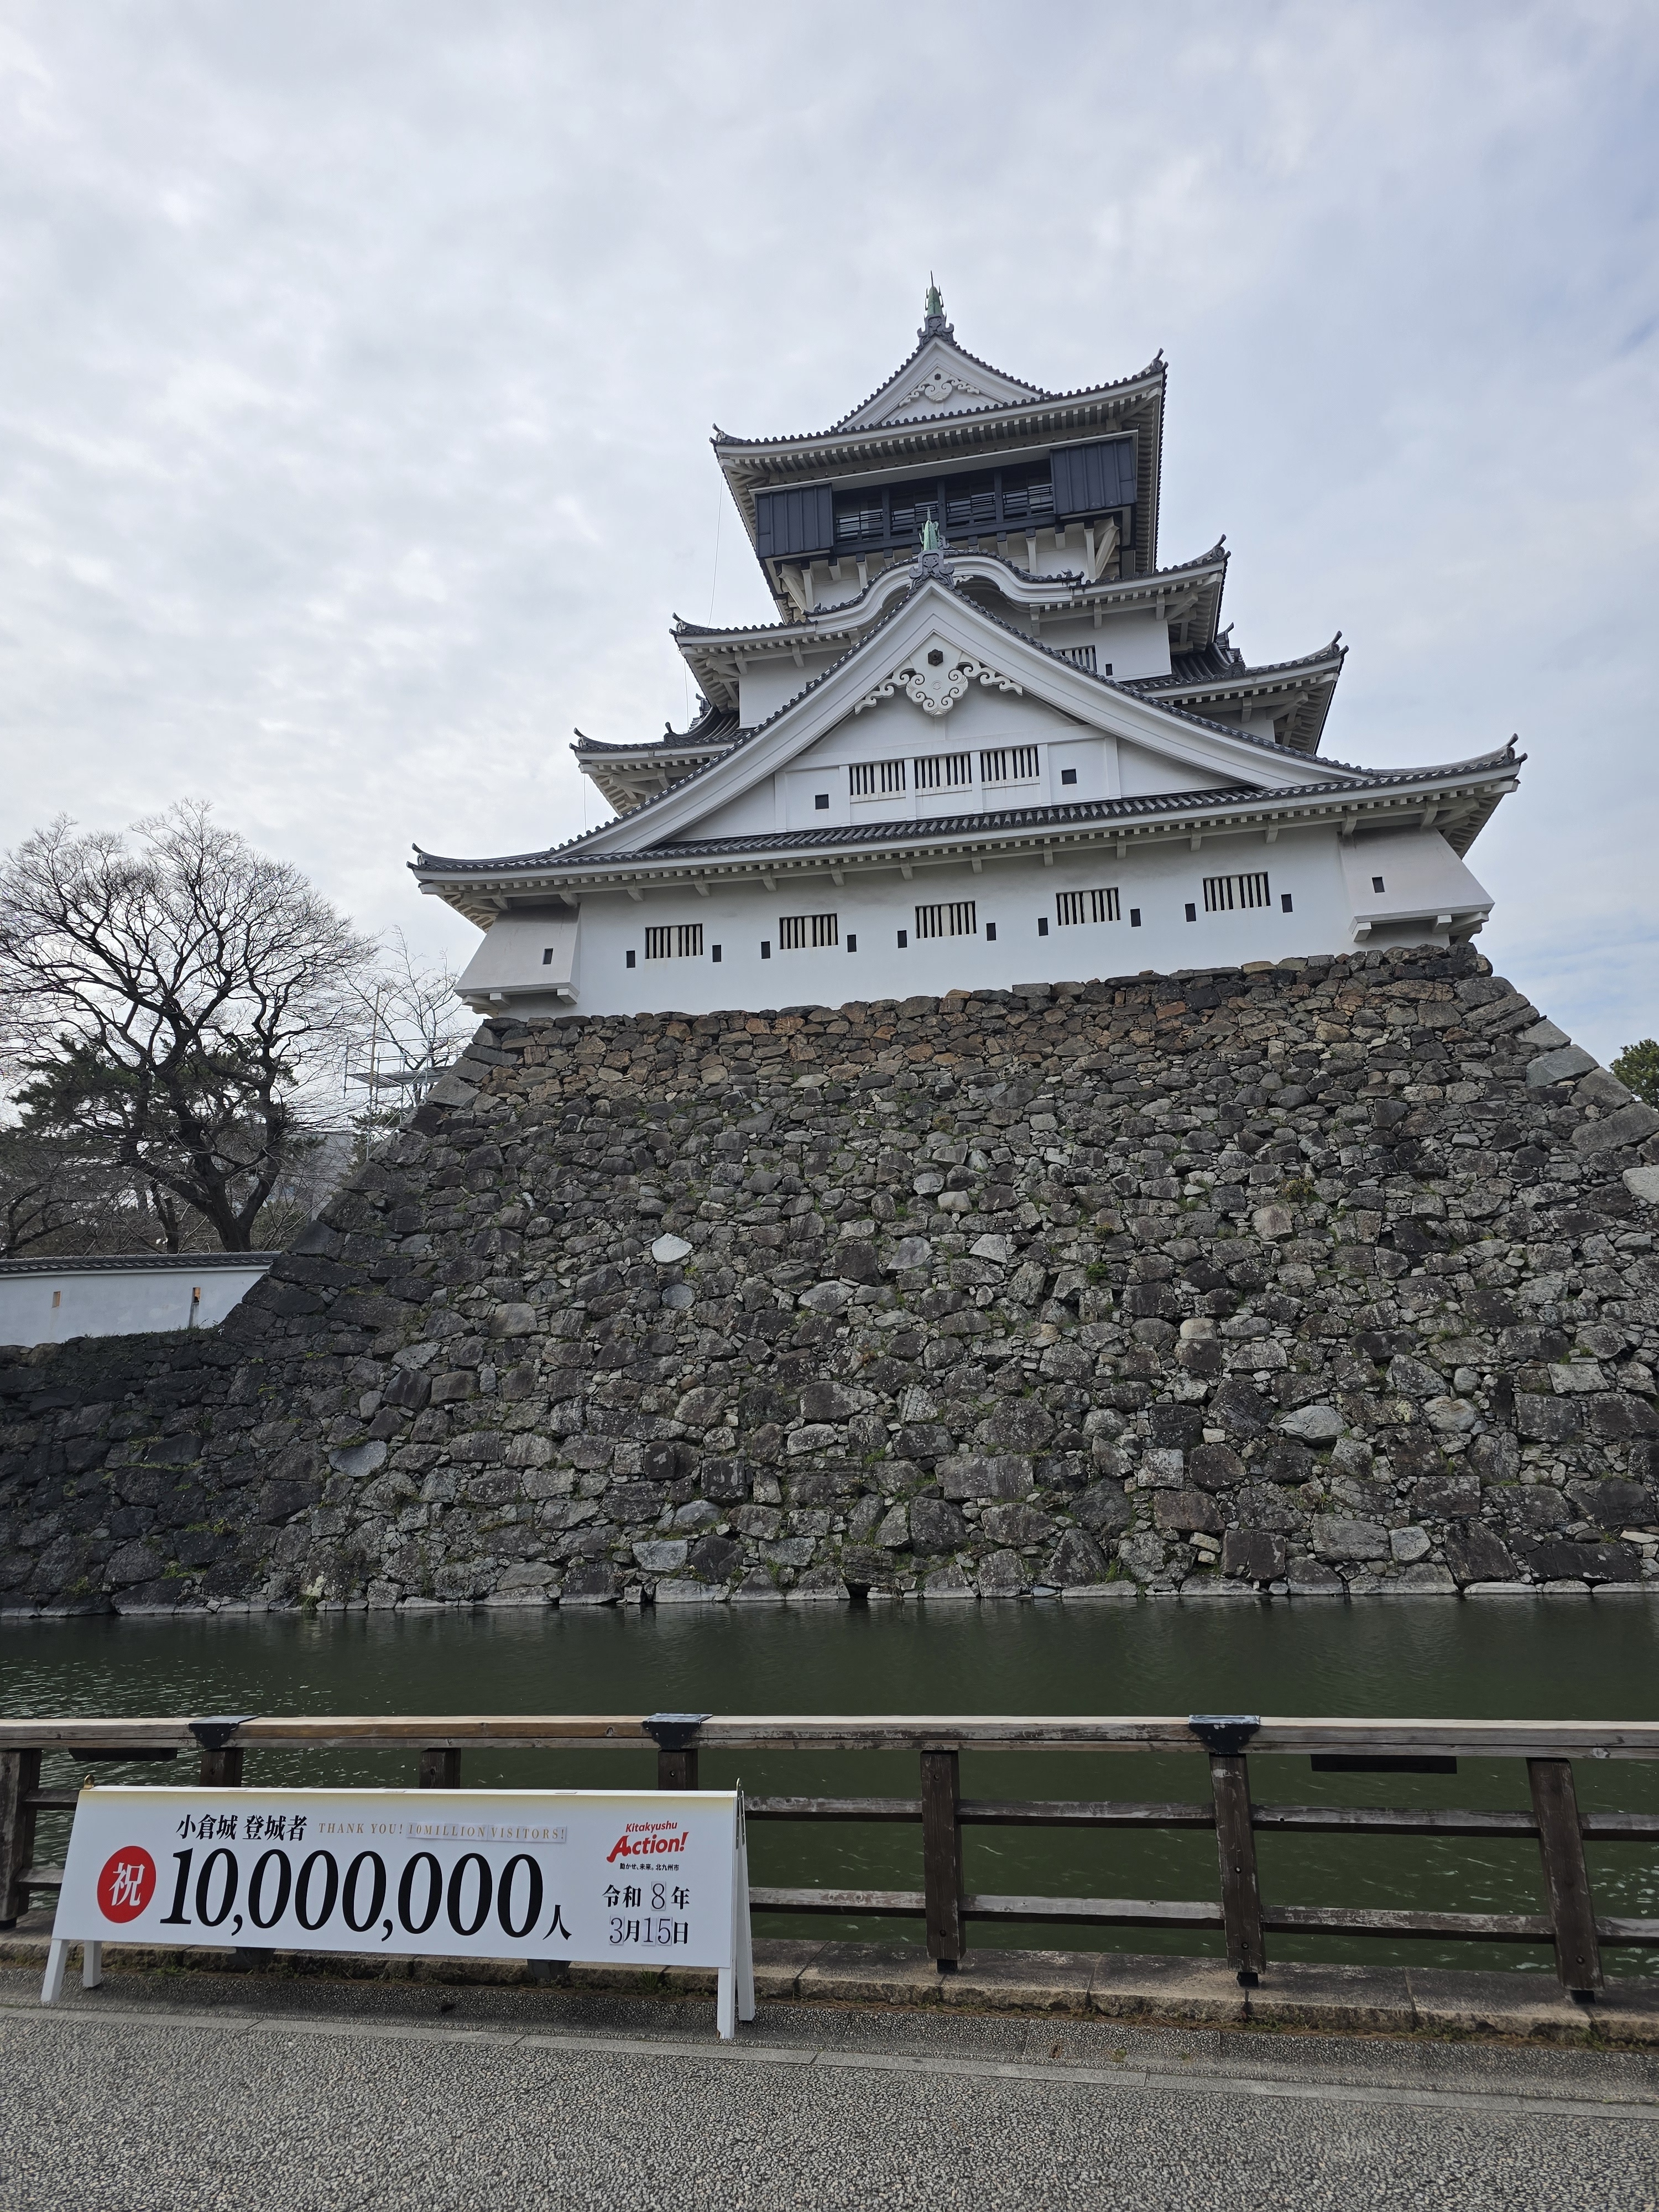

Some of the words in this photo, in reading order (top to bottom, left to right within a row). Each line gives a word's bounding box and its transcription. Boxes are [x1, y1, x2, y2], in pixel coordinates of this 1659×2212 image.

[175, 1814, 238, 1840] 小倉城
[242, 1814, 307, 1841] 登城者
[319, 1823, 364, 1834] THANK
[371, 1823, 403, 1834] YOU!
[491, 1827, 565, 1840] VISITORS!
[625, 1820, 678, 1833] Kitakyushu
[606, 1832, 690, 1863] Action!
[108, 1862, 145, 1907] 祝
[609, 1917, 688, 1944] 3月15日
